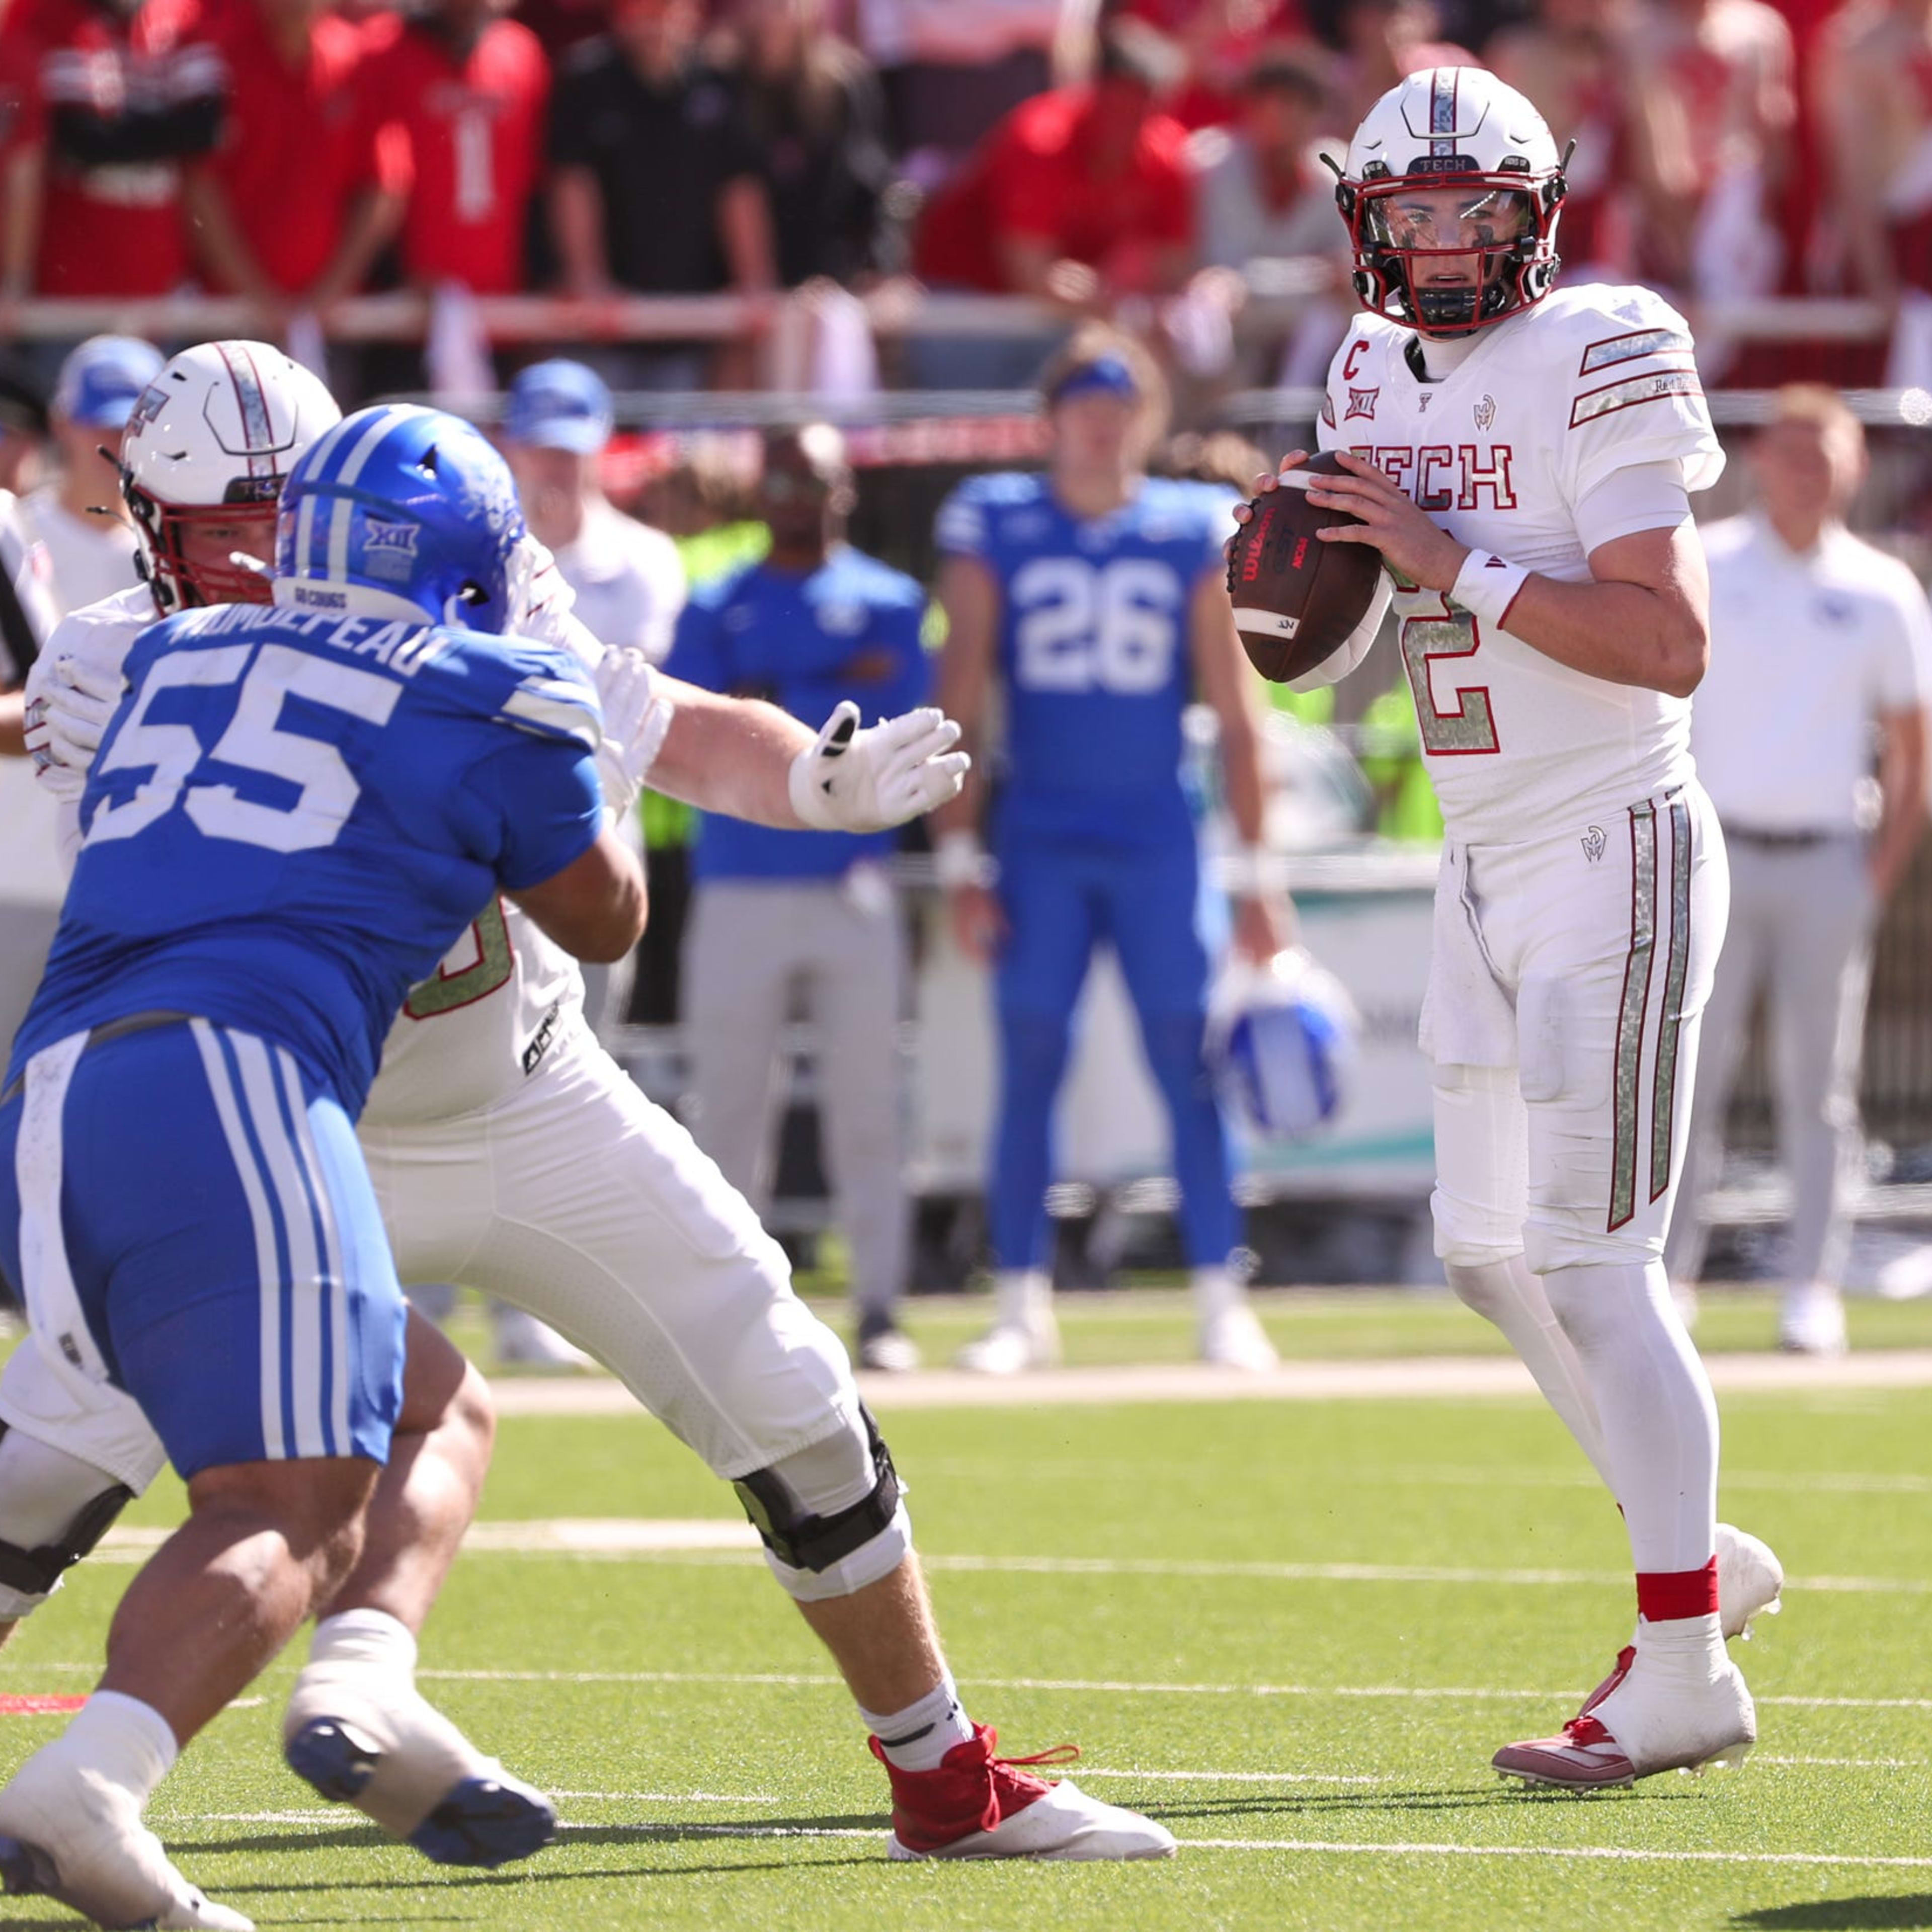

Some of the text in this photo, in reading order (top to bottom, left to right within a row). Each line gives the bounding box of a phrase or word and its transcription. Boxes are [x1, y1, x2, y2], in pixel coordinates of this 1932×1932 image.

[1420, 158, 1466, 172] TECH
[1343, 340, 1369, 380] C
[1243, 507, 1278, 582] Wilson
[1291, 536, 1310, 570] NCAA
[1010, 555, 1183, 694] 26
[1384, 528, 1500, 755] 2
[80, 642, 403, 853] 55
